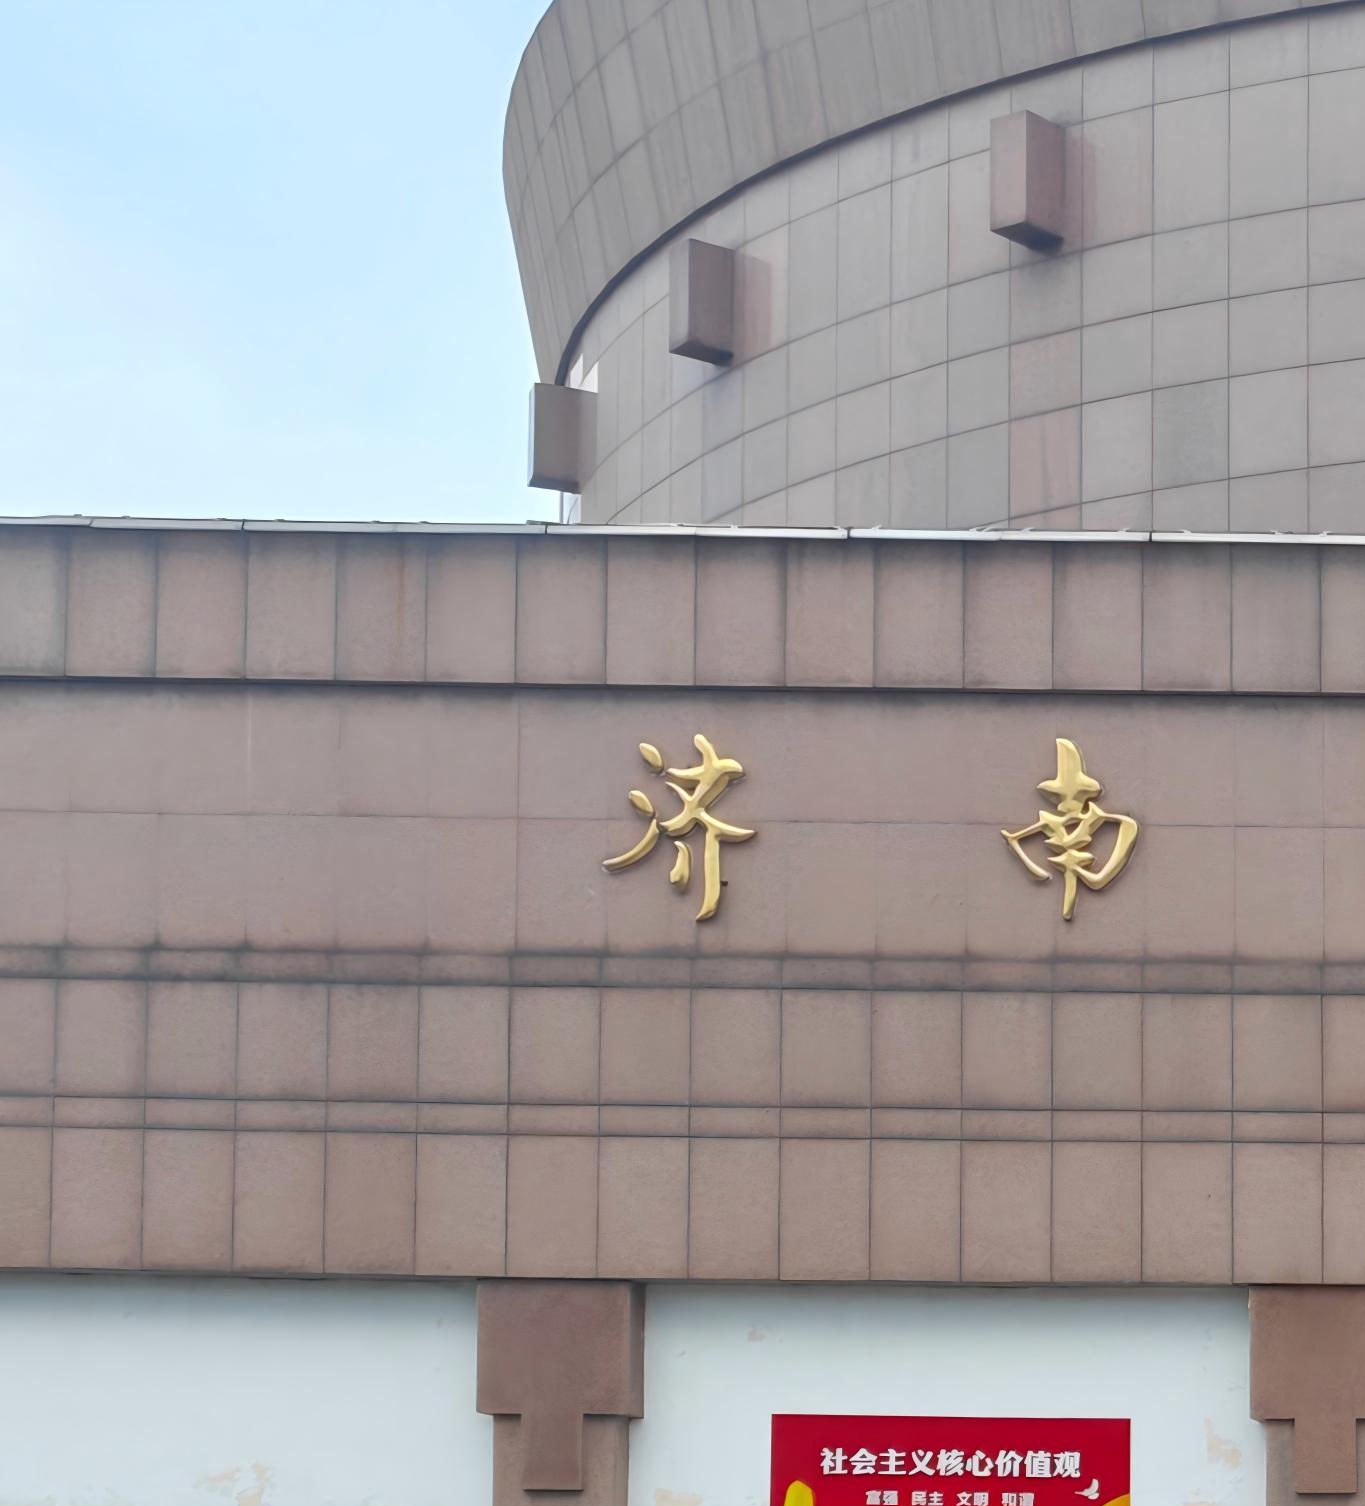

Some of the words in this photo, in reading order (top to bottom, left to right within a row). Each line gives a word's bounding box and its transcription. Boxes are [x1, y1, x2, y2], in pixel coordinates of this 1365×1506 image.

[820, 1447, 1081, 1478] 社会主义核心价值观
[911, 1490, 944, 1506] 民主
[956, 1491, 989, 1506] 文明
